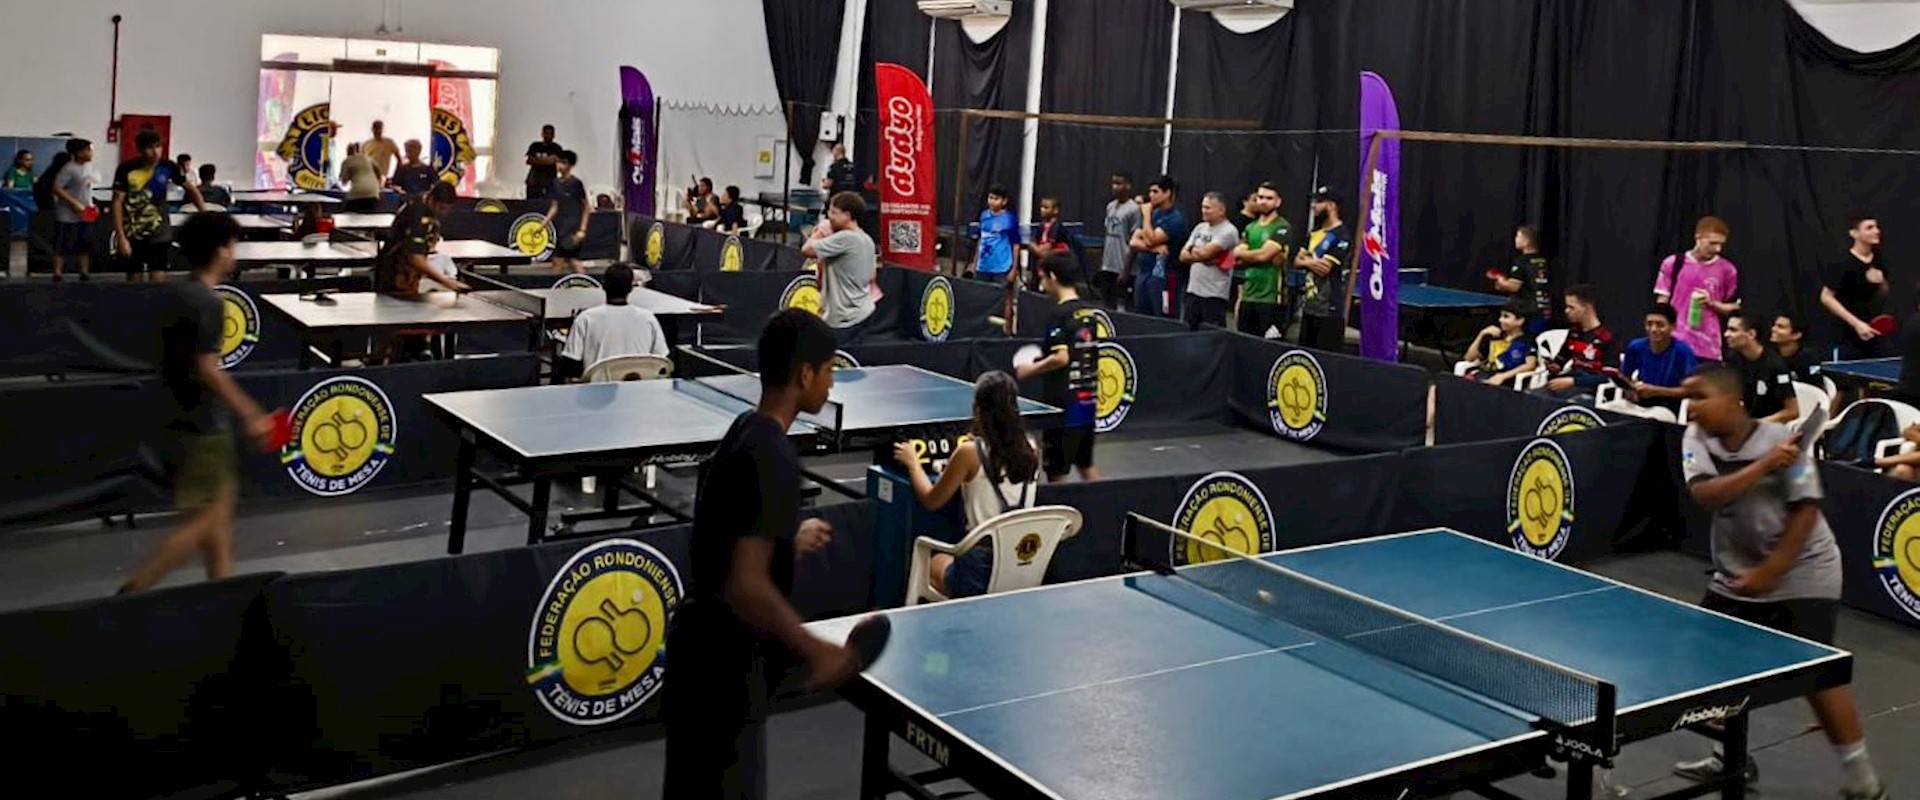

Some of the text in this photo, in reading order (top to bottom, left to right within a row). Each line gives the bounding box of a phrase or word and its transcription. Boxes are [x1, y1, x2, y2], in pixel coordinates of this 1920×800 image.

[885, 96, 916, 197] dydyo
[328, 480, 346, 491] DE
[348, 460, 380, 487] MESA
[540, 551, 677, 658] FEDERAÇÃO RONDONIENSE
[592, 699, 616, 716] DE
[620, 666, 665, 708] MESA
[906, 720, 950, 768] FRTM
